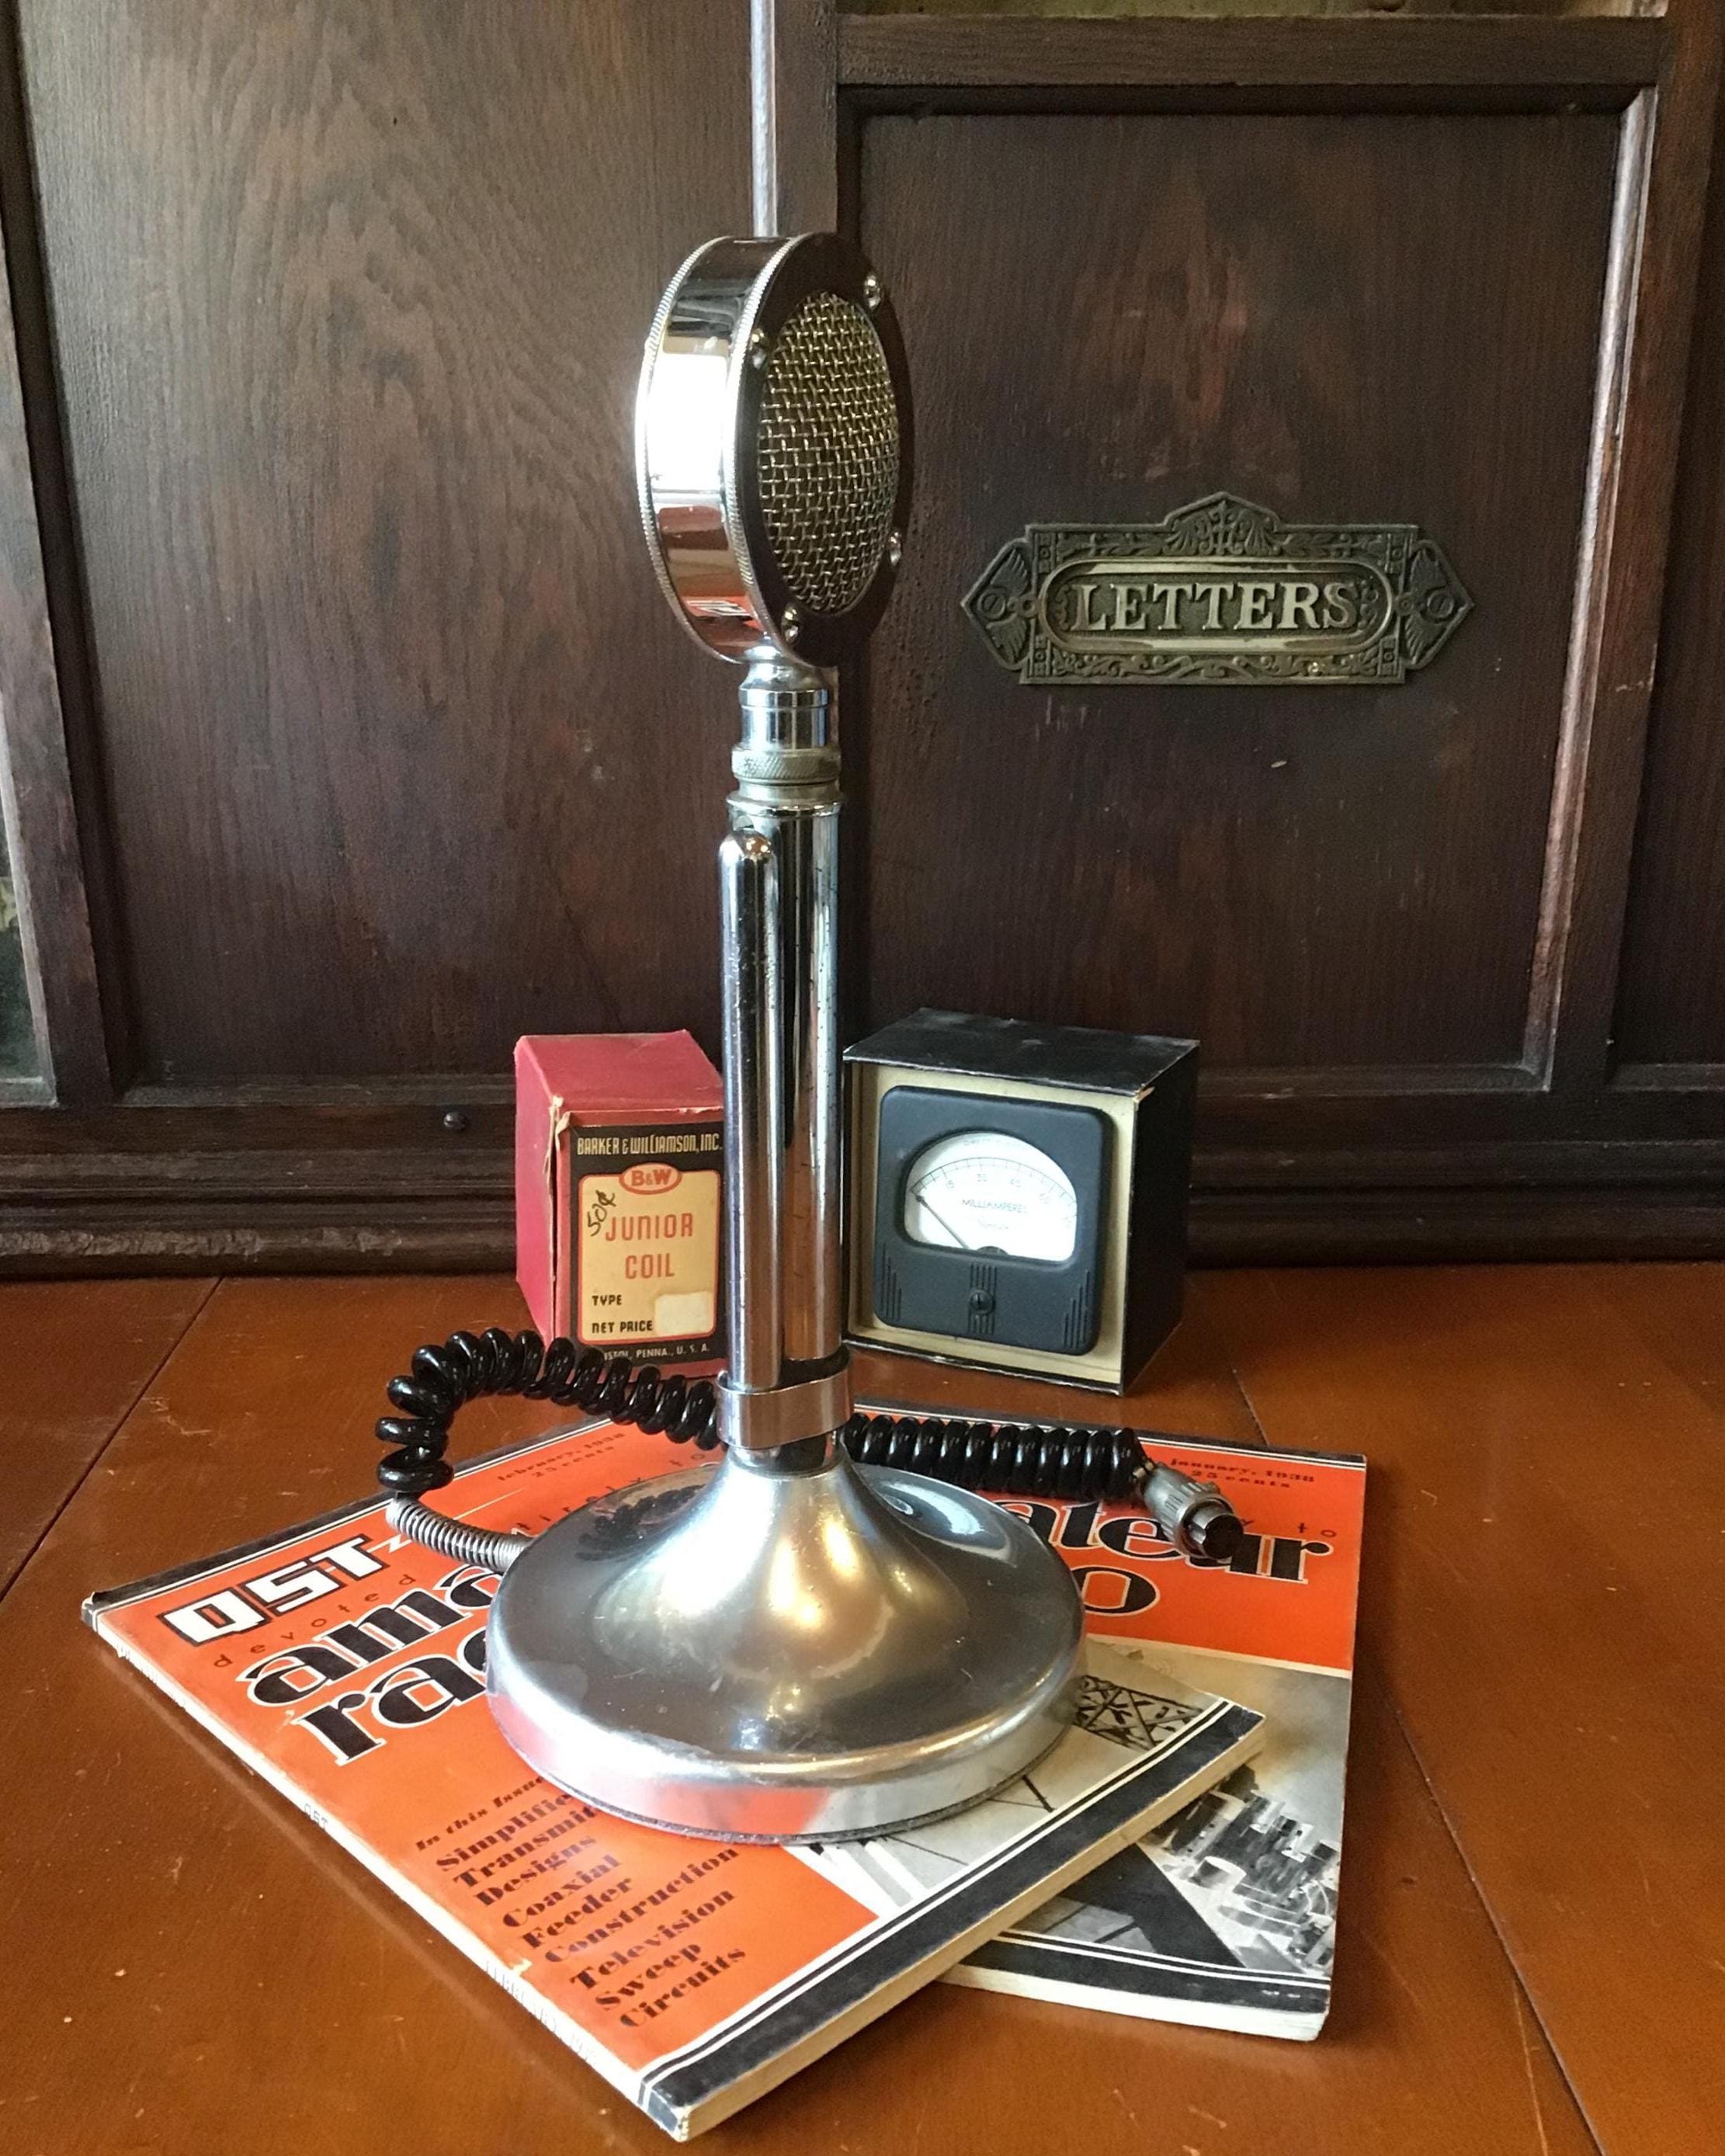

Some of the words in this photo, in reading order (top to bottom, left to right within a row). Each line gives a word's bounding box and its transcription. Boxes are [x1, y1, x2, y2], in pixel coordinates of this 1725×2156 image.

[1070, 582, 1358, 630] LETTERS
[577, 1137, 620, 1155] BARKER
[700, 1134, 723, 1152] INC.
[631, 1170, 672, 1187] B&W
[606, 1212, 693, 1242] JUNIOR
[592, 1294, 622, 1307] TYPE
[625, 1253, 675, 1279] COIL
[592, 1321, 615, 1334] NET
[620, 1319, 654, 1332] PRICE
[155, 1533, 390, 1647] QST
[213, 1574, 417, 1668] devoted
[436, 1791, 573, 1872] Simplifie
[453, 1804, 597, 1888] Transmit
[474, 1835, 598, 1907] Designs
[502, 1853, 623, 1929] Coaxial
[545, 1846, 740, 1963] Construction
[521, 1877, 633, 1949] Feeder
[569, 1889, 736, 1990] Television
[595, 1943, 702, 2011] Sweep
[619, 1948, 746, 2028] Circuits
